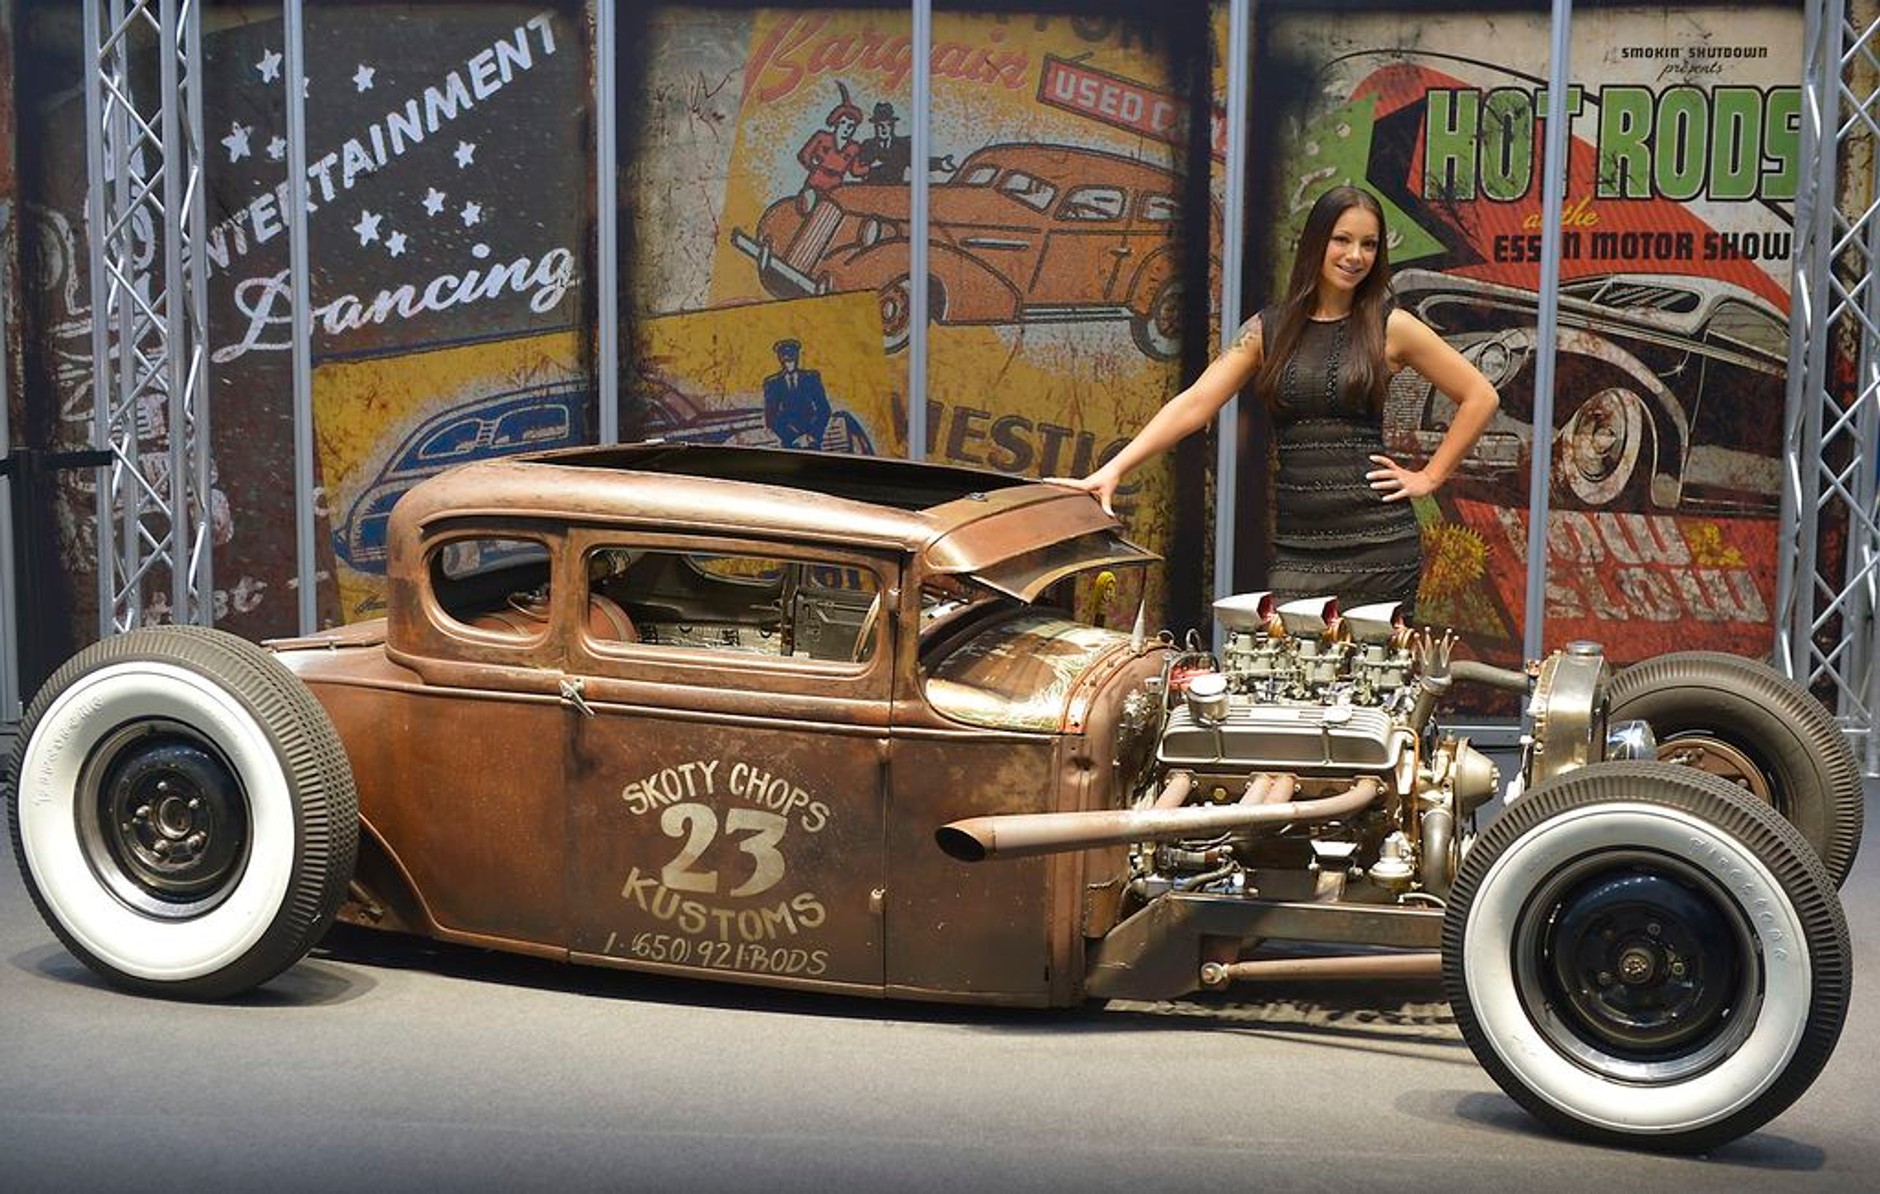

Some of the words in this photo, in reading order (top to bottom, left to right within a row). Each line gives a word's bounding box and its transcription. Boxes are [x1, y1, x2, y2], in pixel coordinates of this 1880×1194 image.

[1688, 46, 1768, 59] SHUTDOWN
[1055, 70, 1143, 123] USED
[1595, 84, 1801, 202] RODS
[1493, 231, 1581, 263] ESSN
[1590, 231, 1694, 261] MOTOR
[1703, 231, 1791, 261] SHOW
[211, 246, 578, 363] Dancing
[621, 760, 719, 816] SKOTY
[728, 762, 831, 832] CHOPS
[660, 802, 789, 898] 23
[621, 867, 827, 942] KUSTOMS
